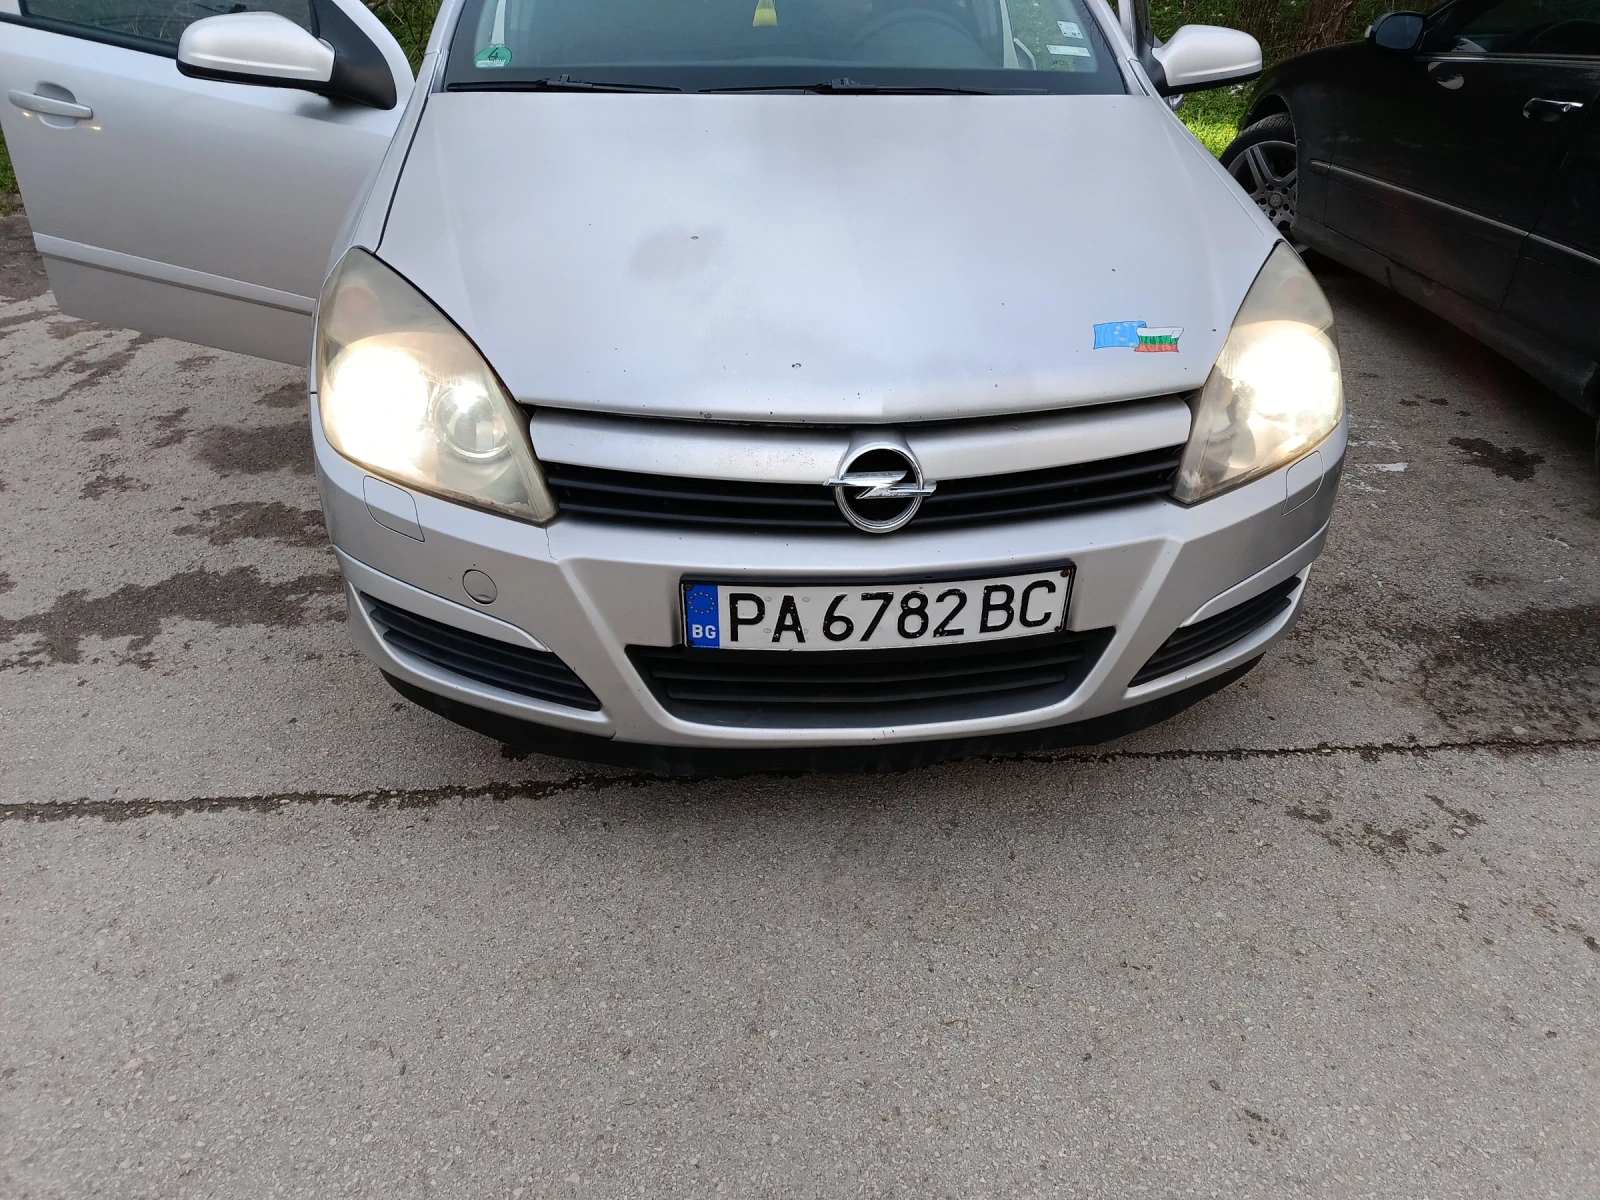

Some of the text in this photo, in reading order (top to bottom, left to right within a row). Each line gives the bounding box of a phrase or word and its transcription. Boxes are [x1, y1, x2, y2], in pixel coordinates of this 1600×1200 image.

[487, 47, 500, 61] 4
[728, 579, 1057, 643] PA 6782 BC
[692, 624, 716, 639] BG
